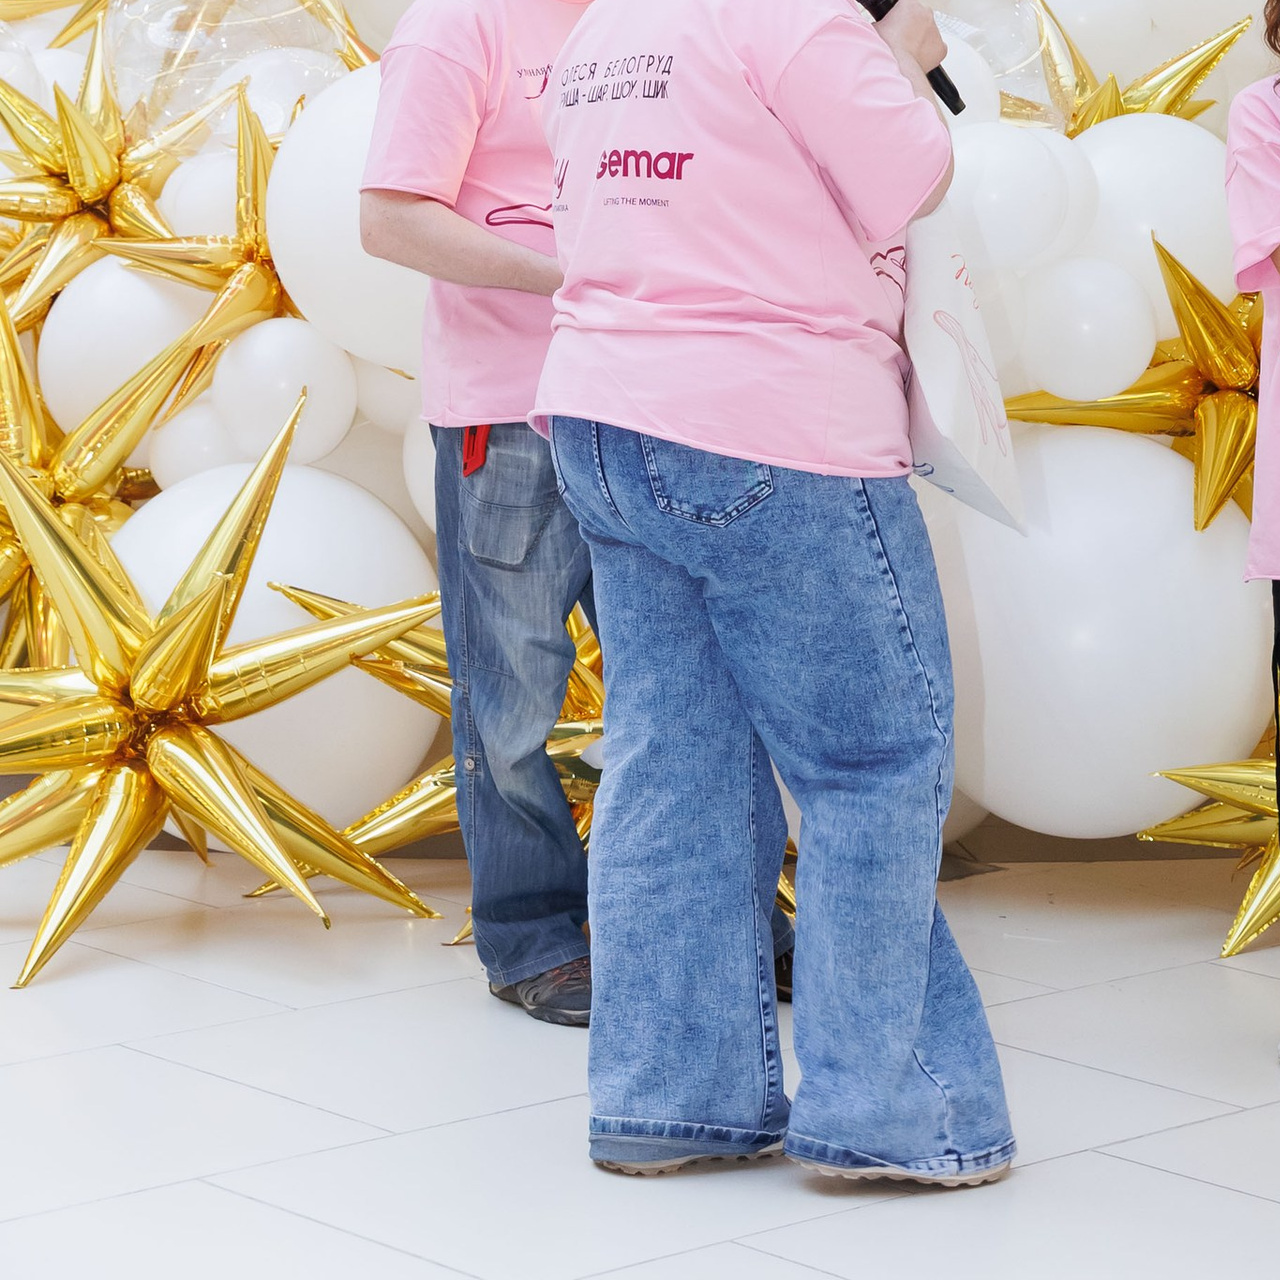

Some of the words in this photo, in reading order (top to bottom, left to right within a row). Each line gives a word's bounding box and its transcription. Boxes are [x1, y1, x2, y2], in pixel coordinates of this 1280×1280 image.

[604, 54, 674, 78] БЕЛОГРУД
[621, 197, 637, 206] THE
[639, 198, 670, 207] MOMENT
